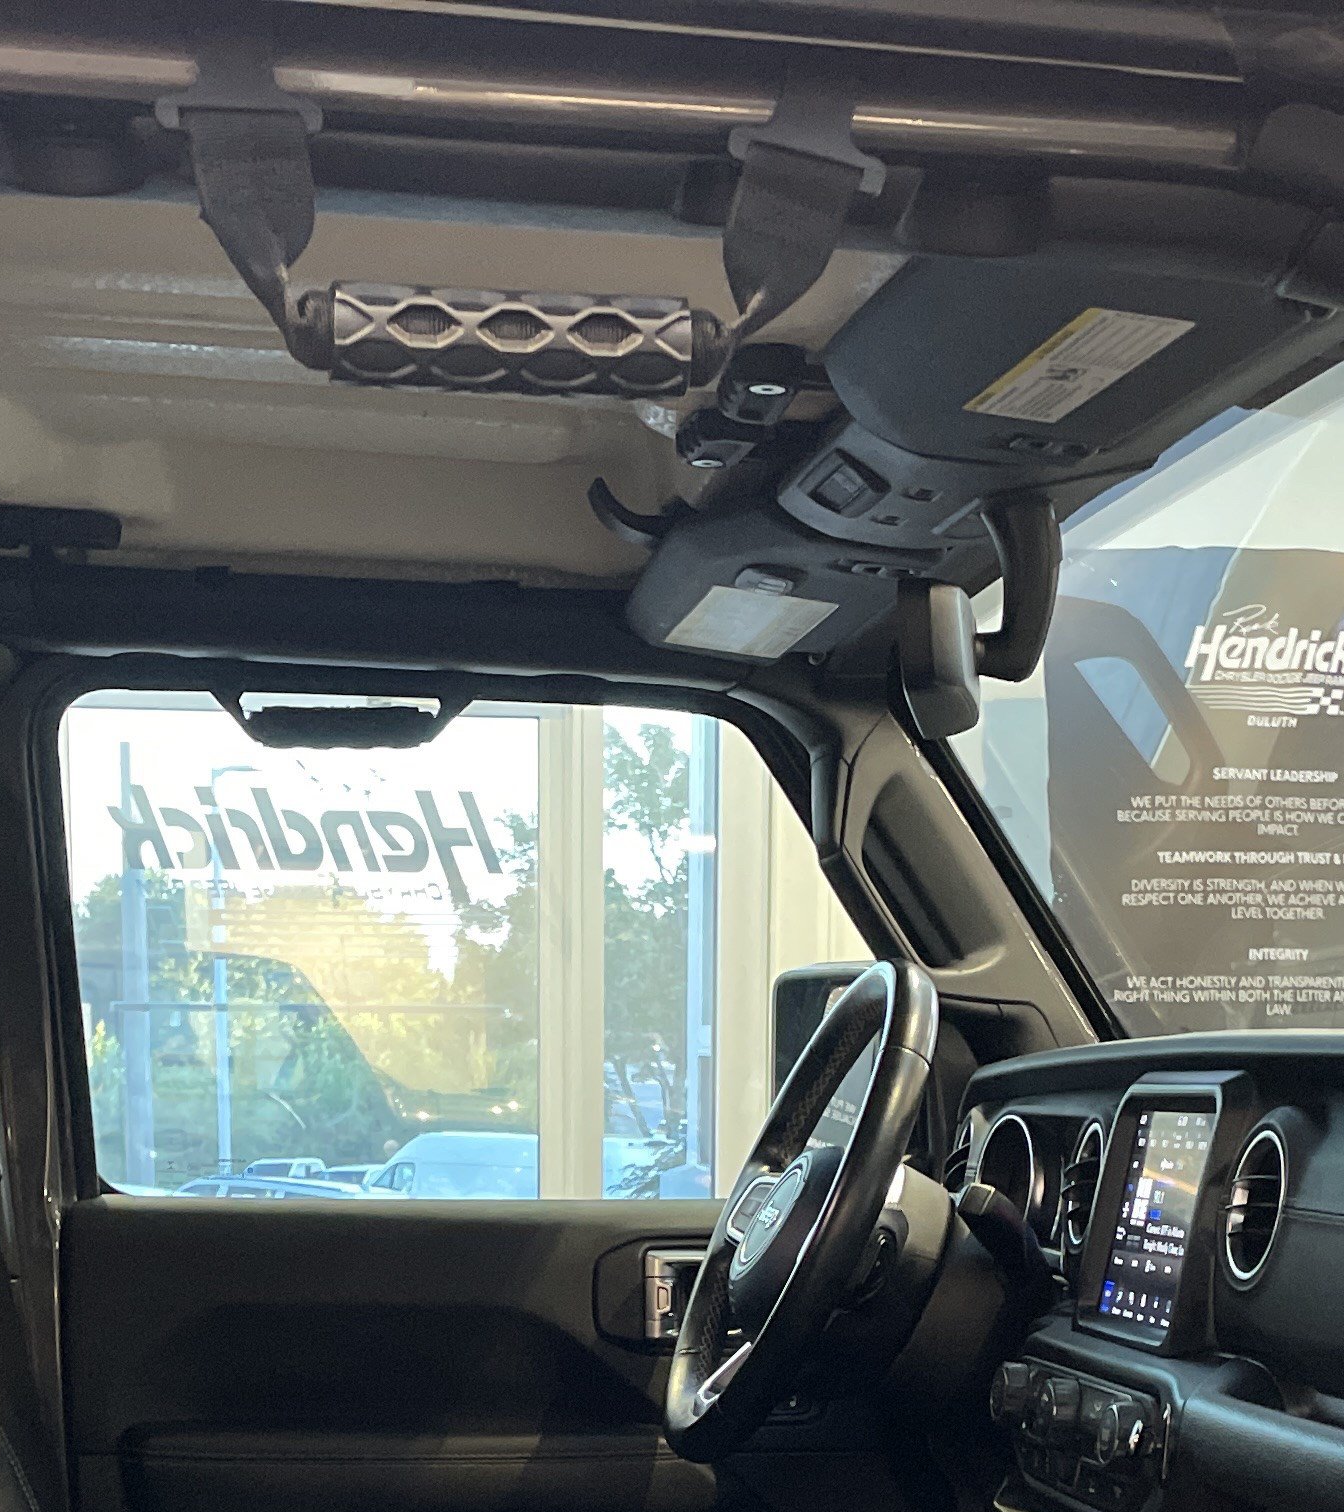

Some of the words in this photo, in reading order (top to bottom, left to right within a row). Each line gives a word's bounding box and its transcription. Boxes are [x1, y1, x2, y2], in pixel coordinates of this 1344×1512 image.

[1247, 715, 1298, 728] DULUTH
[1213, 767, 1268, 781] SERVANT
[1270, 769, 1339, 783] LEADERSHIP
[1130, 795, 1152, 809] WE
[1155, 795, 1177, 808] PUT
[1180, 795, 1202, 809] THE
[1204, 795, 1244, 809] NEEDS
[1246, 796, 1263, 809] OF
[1265, 796, 1308, 810] OTHERS
[1116, 809, 1172, 822] BECAUSE
[1175, 809, 1226, 822] SERVING
[1229, 809, 1270, 822] PEOPLE
[1273, 810, 1284, 823] IS
[1285, 811, 1315, 823] HOW
[1317, 812, 1335, 825] WE
[1157, 851, 1232, 864] TEAMWORK
[1234, 851, 1294, 865] THROUGH
[1297, 852, 1331, 865] TRUST
[1333, 853, 1341, 865] &
[1131, 879, 1191, 891] DIVERSITY
[1193, 879, 1204, 891] IS
[1206, 878, 1268, 893] STRENGTH,
[1270, 879, 1297, 892] AND
[1298, 879, 1334, 893] WHEN
[1121, 893, 1175, 906] RESPECT
[1177, 893, 1205, 905] ONE
[1267, 893, 1286, 906] WE
[1288, 893, 1336, 906] ACHIEVE
[1231, 906, 1263, 919] LEVEL
[1248, 948, 1309, 961] INTEGRITY
[1127, 976, 1147, 989] WE
[1150, 976, 1173, 989] ACT
[1175, 976, 1237, 989] HONESTLY
[1239, 976, 1265, 988] AND
[1113, 989, 1150, 1002] RIGHT
[1153, 989, 1190, 1003] THING
[1192, 989, 1236, 1002] WITHIN
[1238, 989, 1271, 1003] BOTH
[1273, 990, 1295, 1002] THE
[1296, 990, 1331, 1002] LETTER
